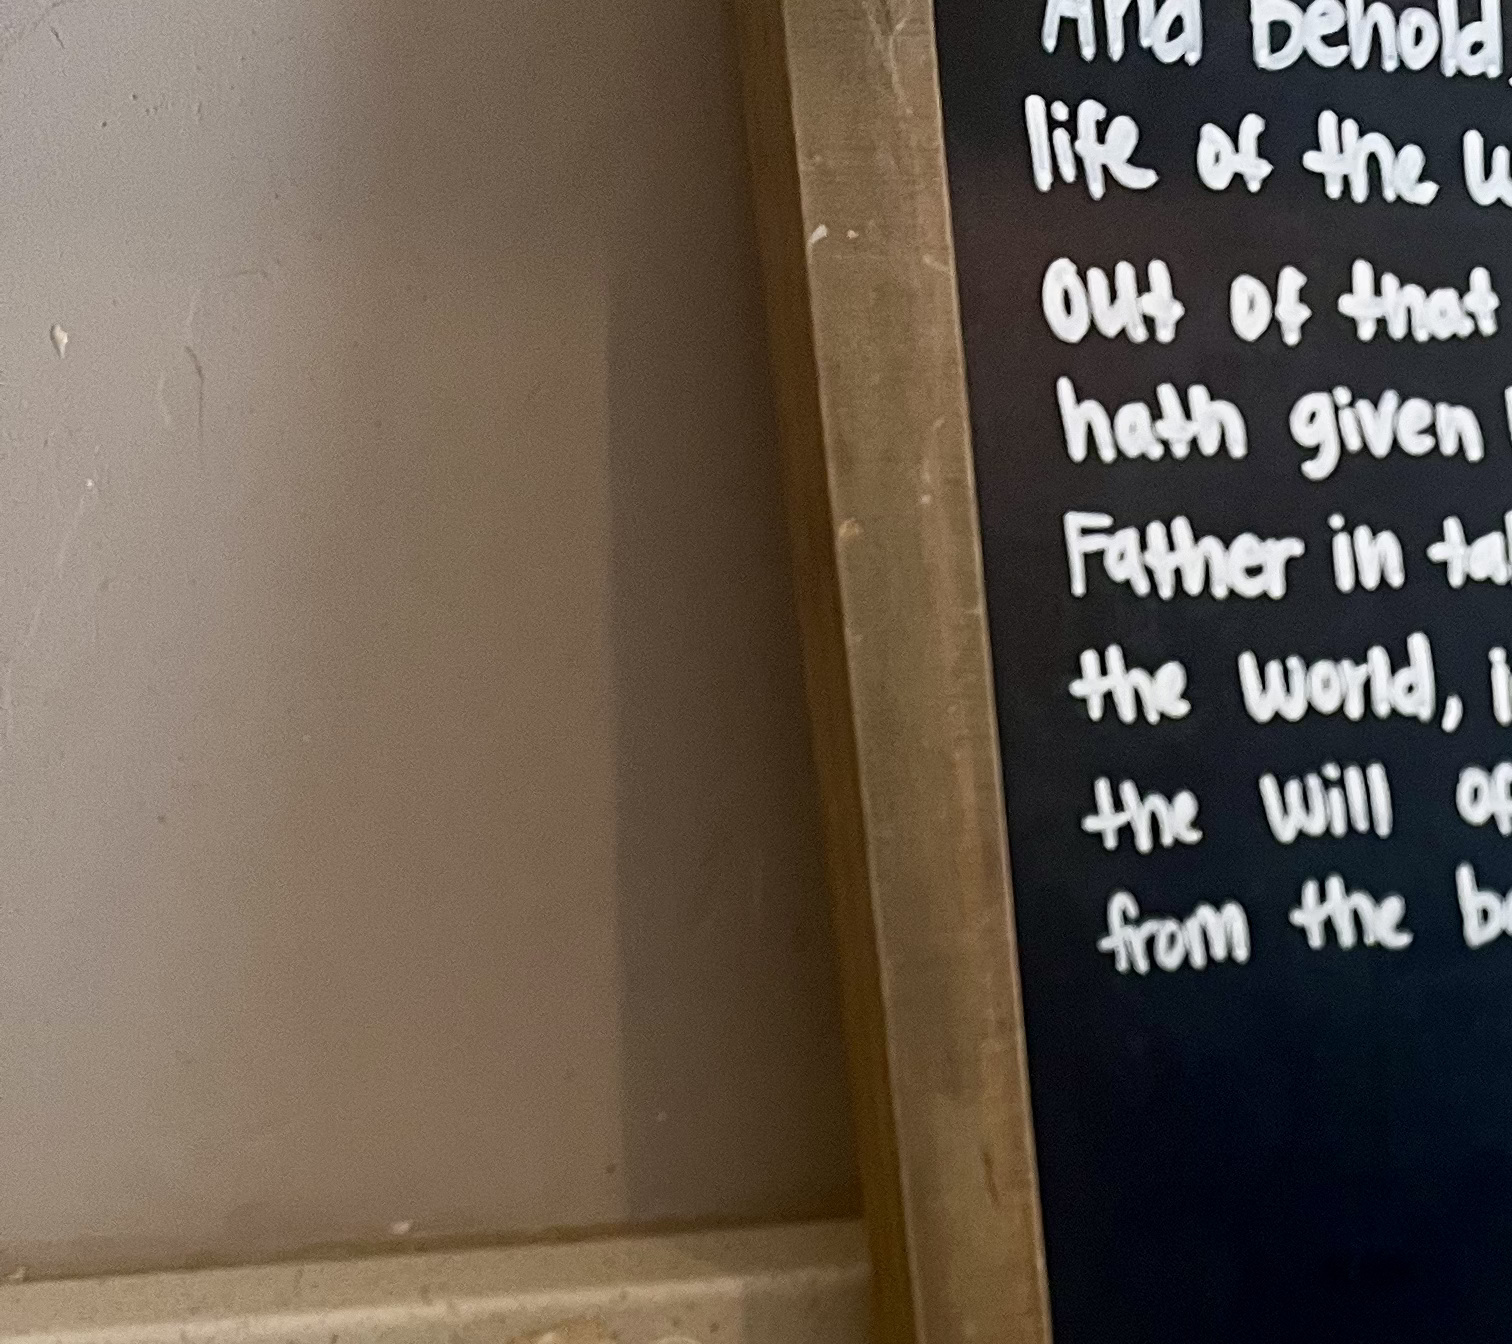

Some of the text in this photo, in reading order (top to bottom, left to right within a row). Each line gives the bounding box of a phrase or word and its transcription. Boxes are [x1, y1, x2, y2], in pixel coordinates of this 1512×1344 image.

[1041, 0, 1204, 67] And
[1023, 93, 1160, 202] life
[1195, 112, 1275, 194] of
[1301, 108, 1441, 207] the
[1229, 264, 1313, 347] of
[1336, 258, 1501, 344] that
[1055, 375, 1248, 465] hath
[1288, 385, 1485, 481] given
[1062, 509, 1306, 601] Father
[1327, 512, 1406, 594] in
[1068, 643, 1192, 726] the
[1081, 776, 1204, 854] the
[1098, 890, 1251, 975] from
[1288, 874, 1414, 950] the
